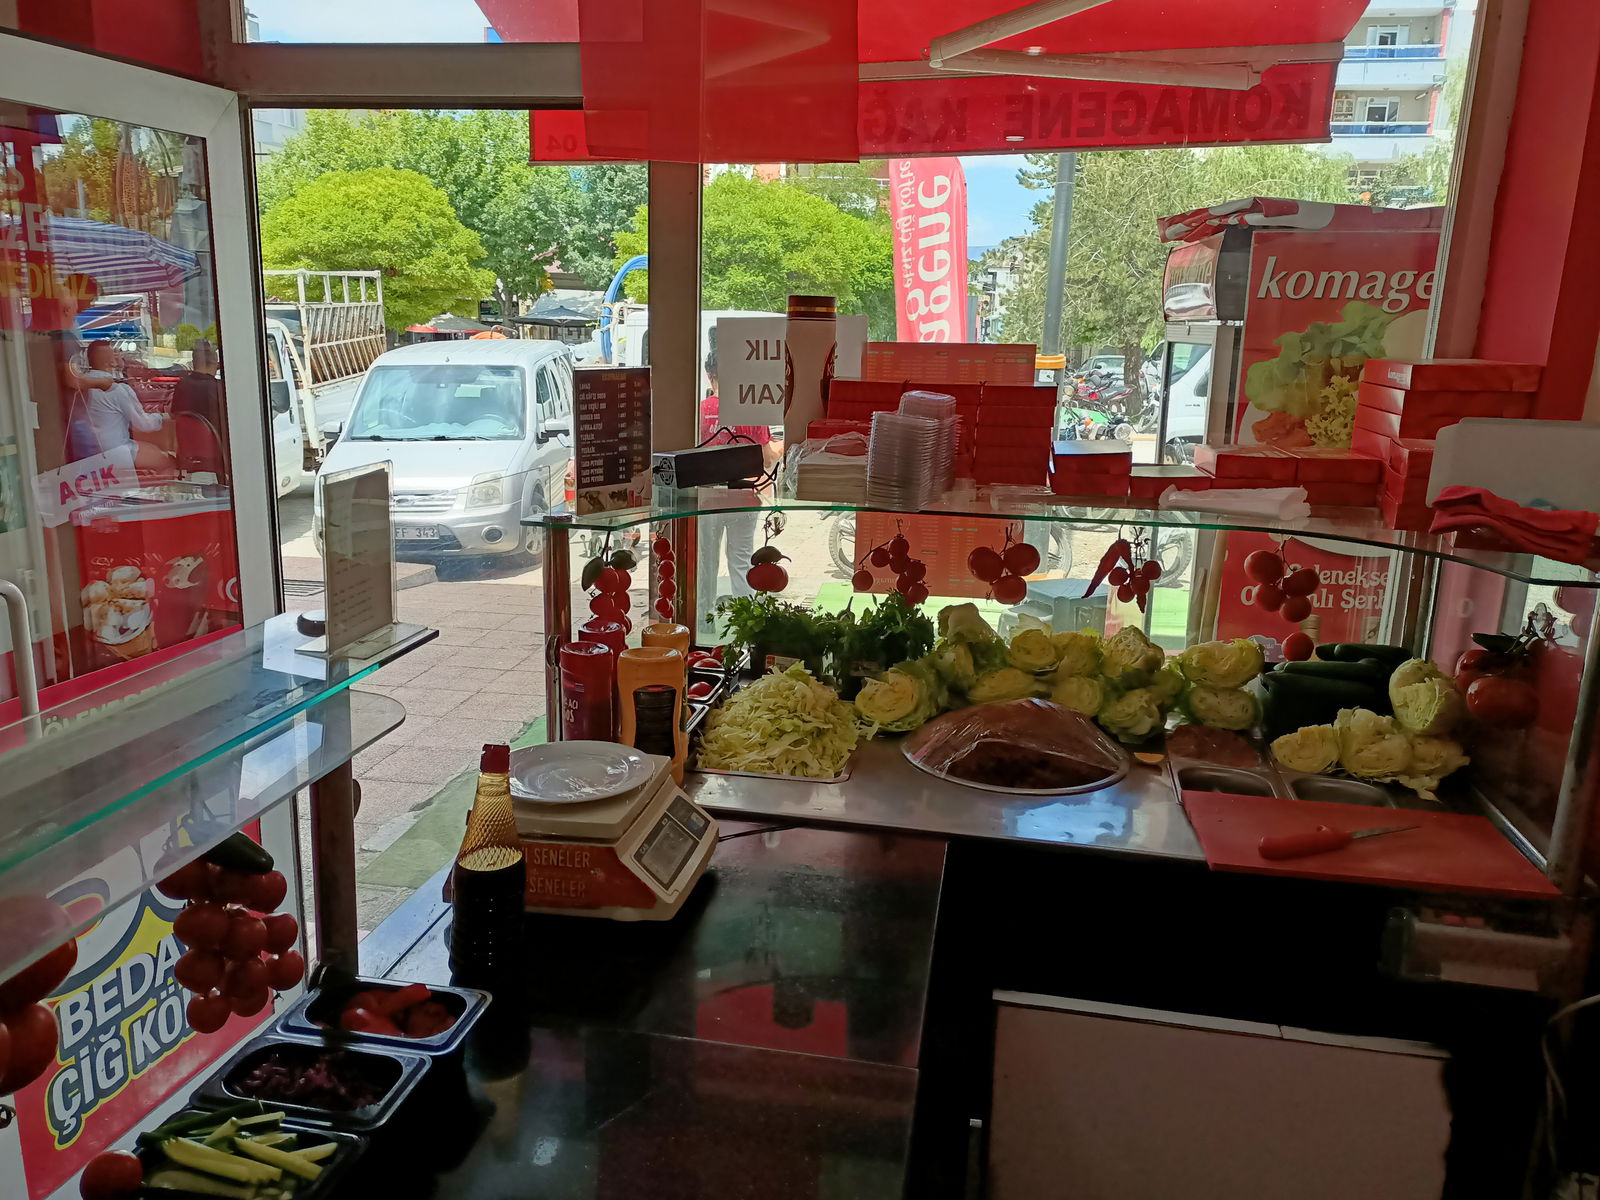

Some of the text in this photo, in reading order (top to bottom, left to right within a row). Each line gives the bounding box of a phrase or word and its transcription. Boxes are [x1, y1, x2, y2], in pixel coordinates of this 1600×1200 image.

[415, 527, 436, 538] 343
[534, 847, 591, 868] SENELER
[529, 876, 586, 898] SENELER
[52, 984, 192, 1136] ÇİĞ KÖ
